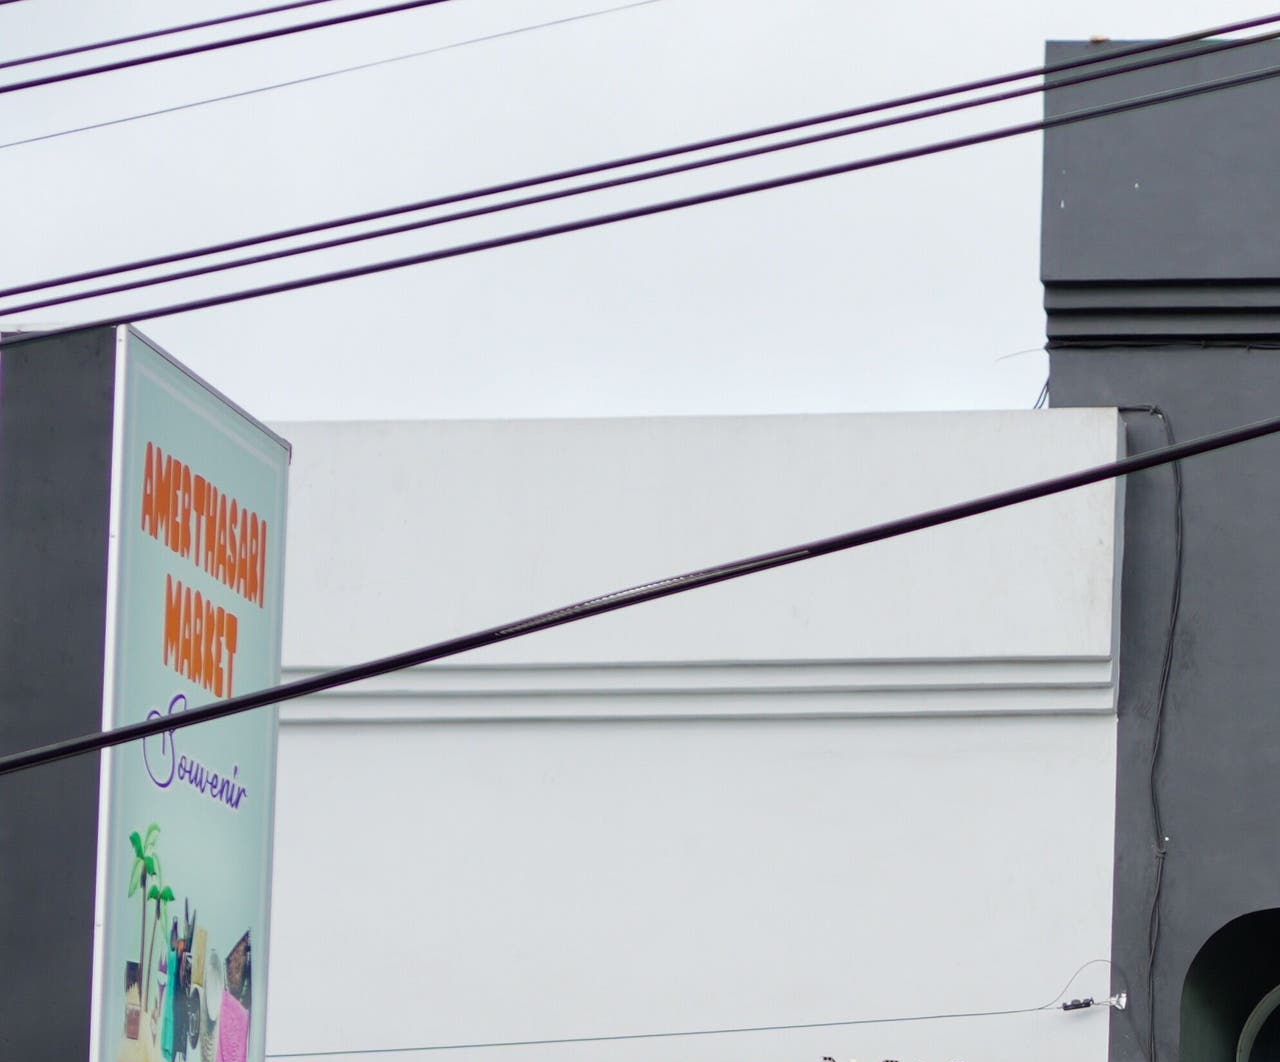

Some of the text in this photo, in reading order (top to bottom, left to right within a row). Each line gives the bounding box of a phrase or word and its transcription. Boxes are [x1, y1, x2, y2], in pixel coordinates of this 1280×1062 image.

[141, 441, 268, 609] AMERTHASARI
[163, 574, 239, 699] MARKET
[142, 694, 247, 810] Souvenir
